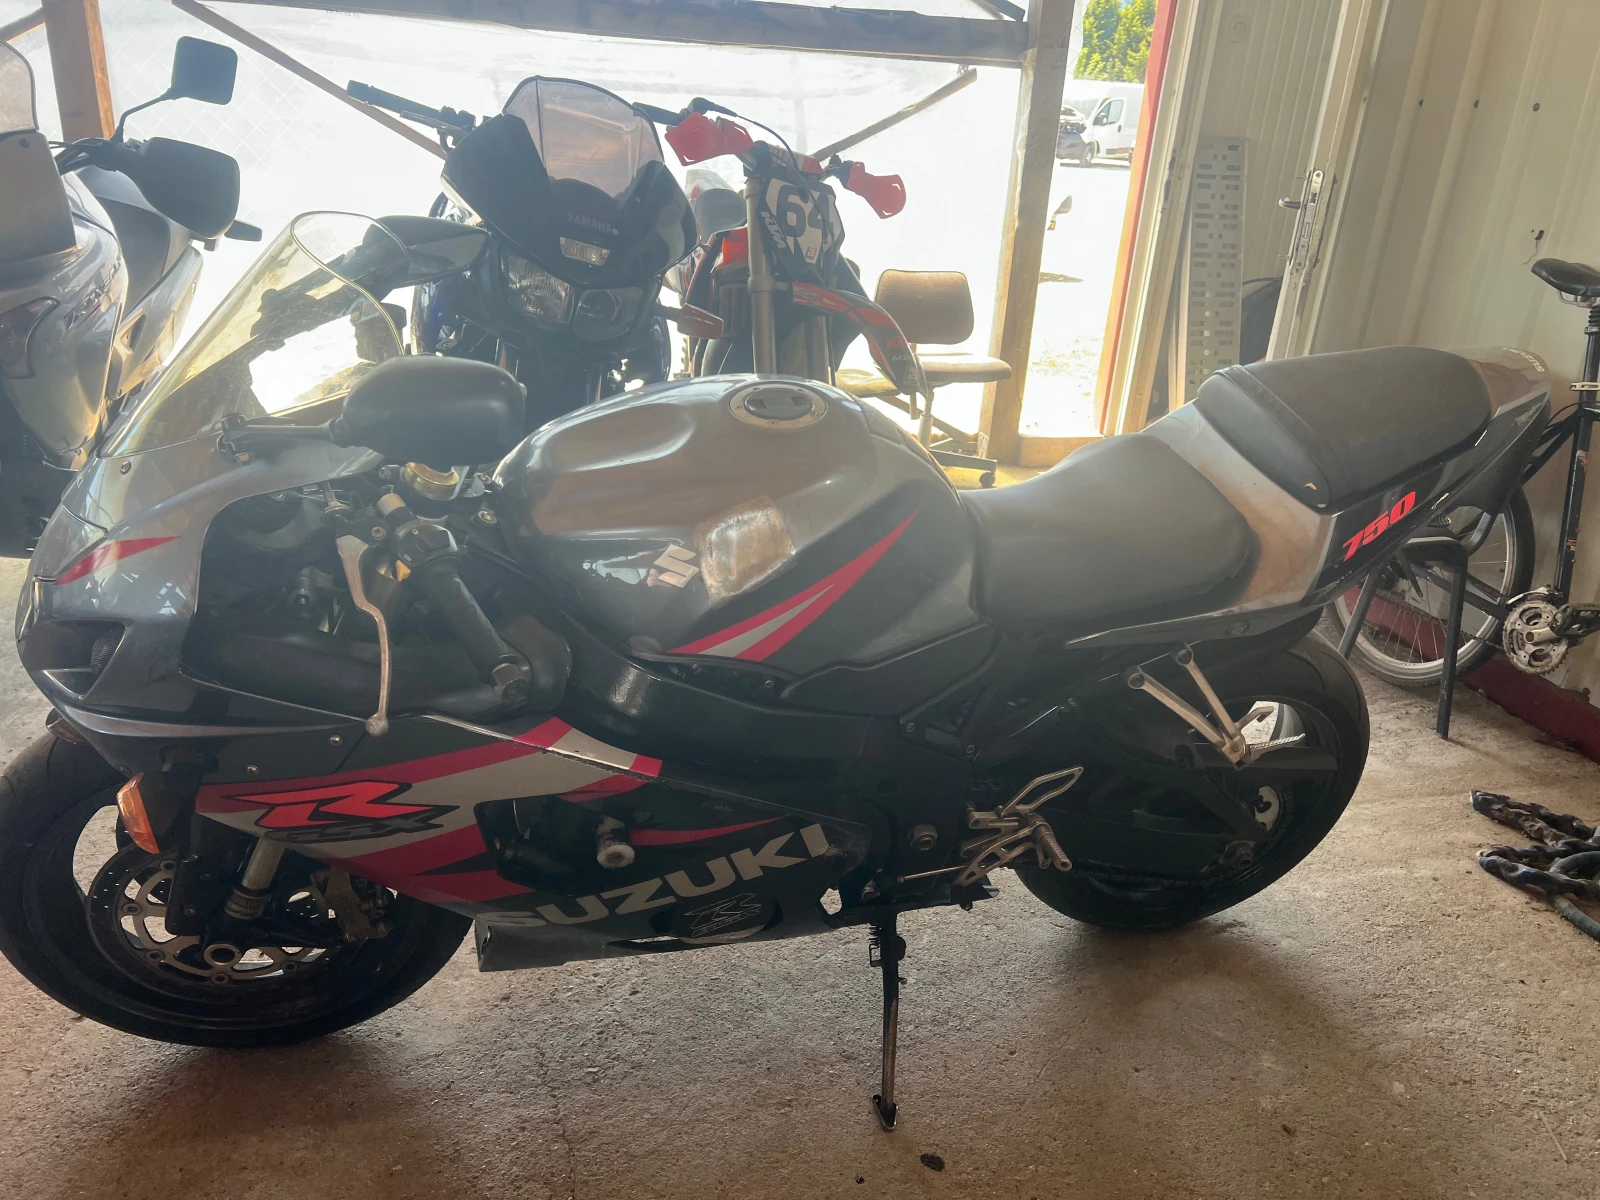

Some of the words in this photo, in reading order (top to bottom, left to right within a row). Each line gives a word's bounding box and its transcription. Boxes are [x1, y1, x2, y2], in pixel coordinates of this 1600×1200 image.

[568, 211, 612, 234] YAMAHA
[776, 184, 833, 238] 64
[1343, 491, 1416, 563] 750
[486, 823, 830, 928] SUZUKI
